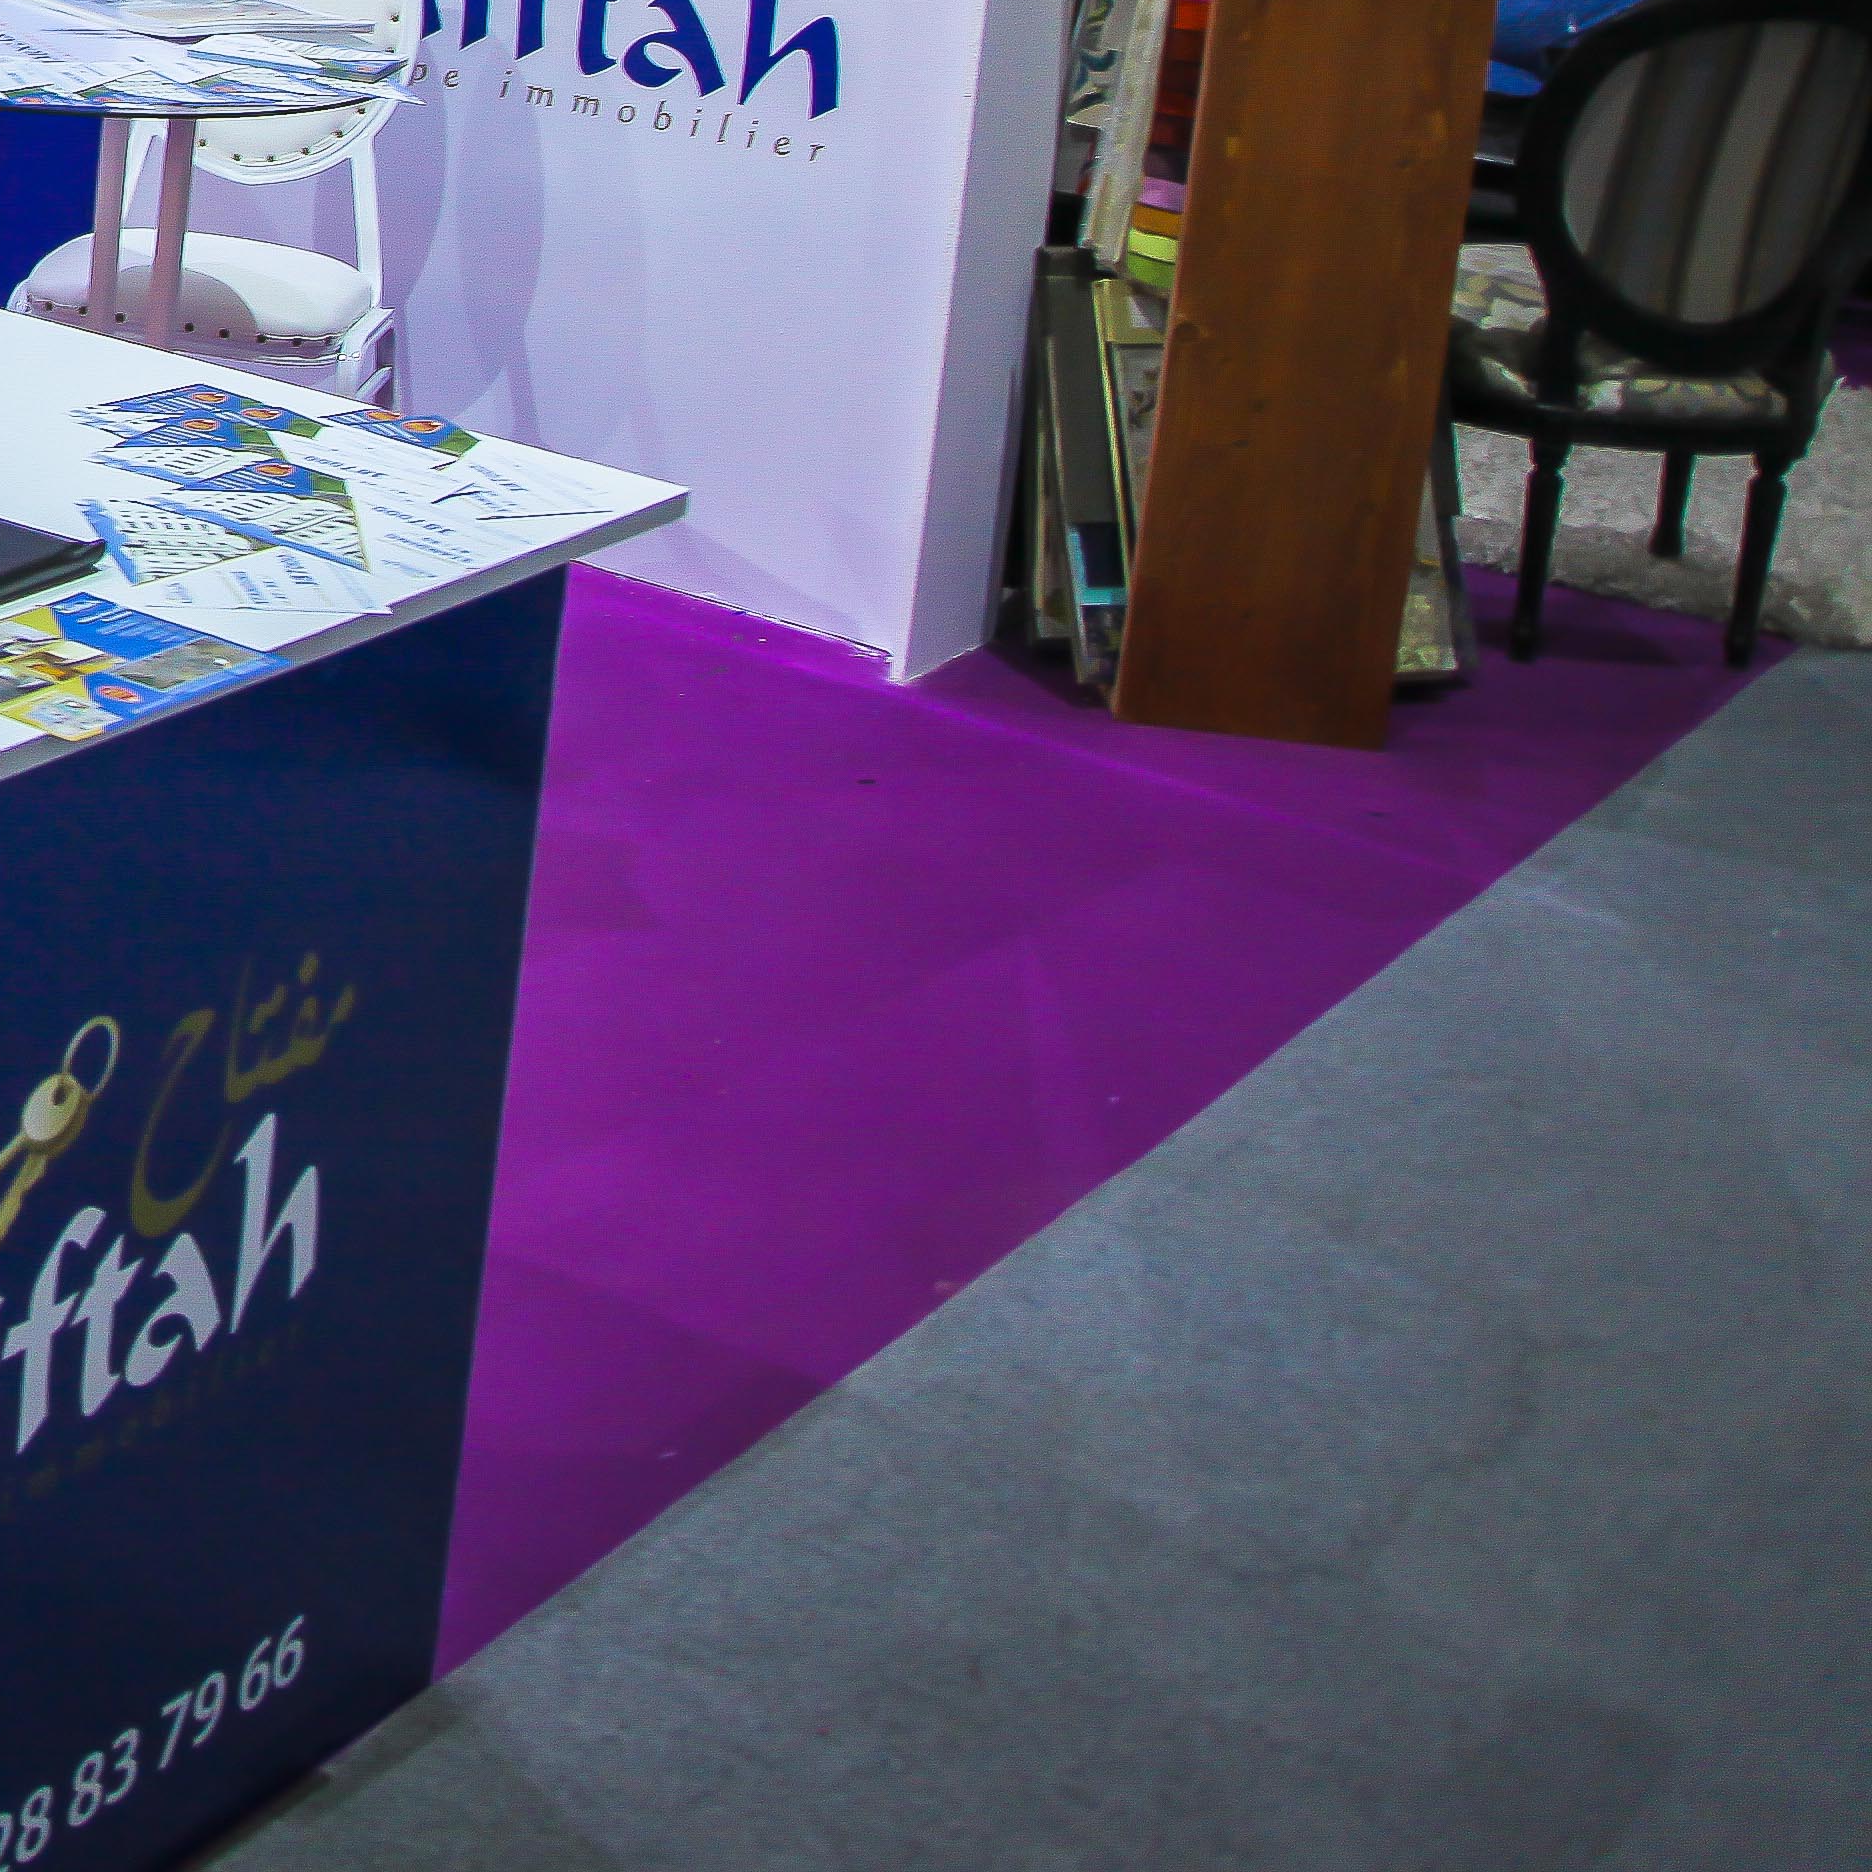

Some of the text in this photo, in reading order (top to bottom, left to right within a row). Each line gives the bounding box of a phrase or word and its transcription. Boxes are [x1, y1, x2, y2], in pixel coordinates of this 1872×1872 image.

[499, 68, 828, 164] immobilier
[67, 1727, 142, 1827] 83
[158, 1670, 226, 1770] 79
[237, 1613, 307, 1712] 66
